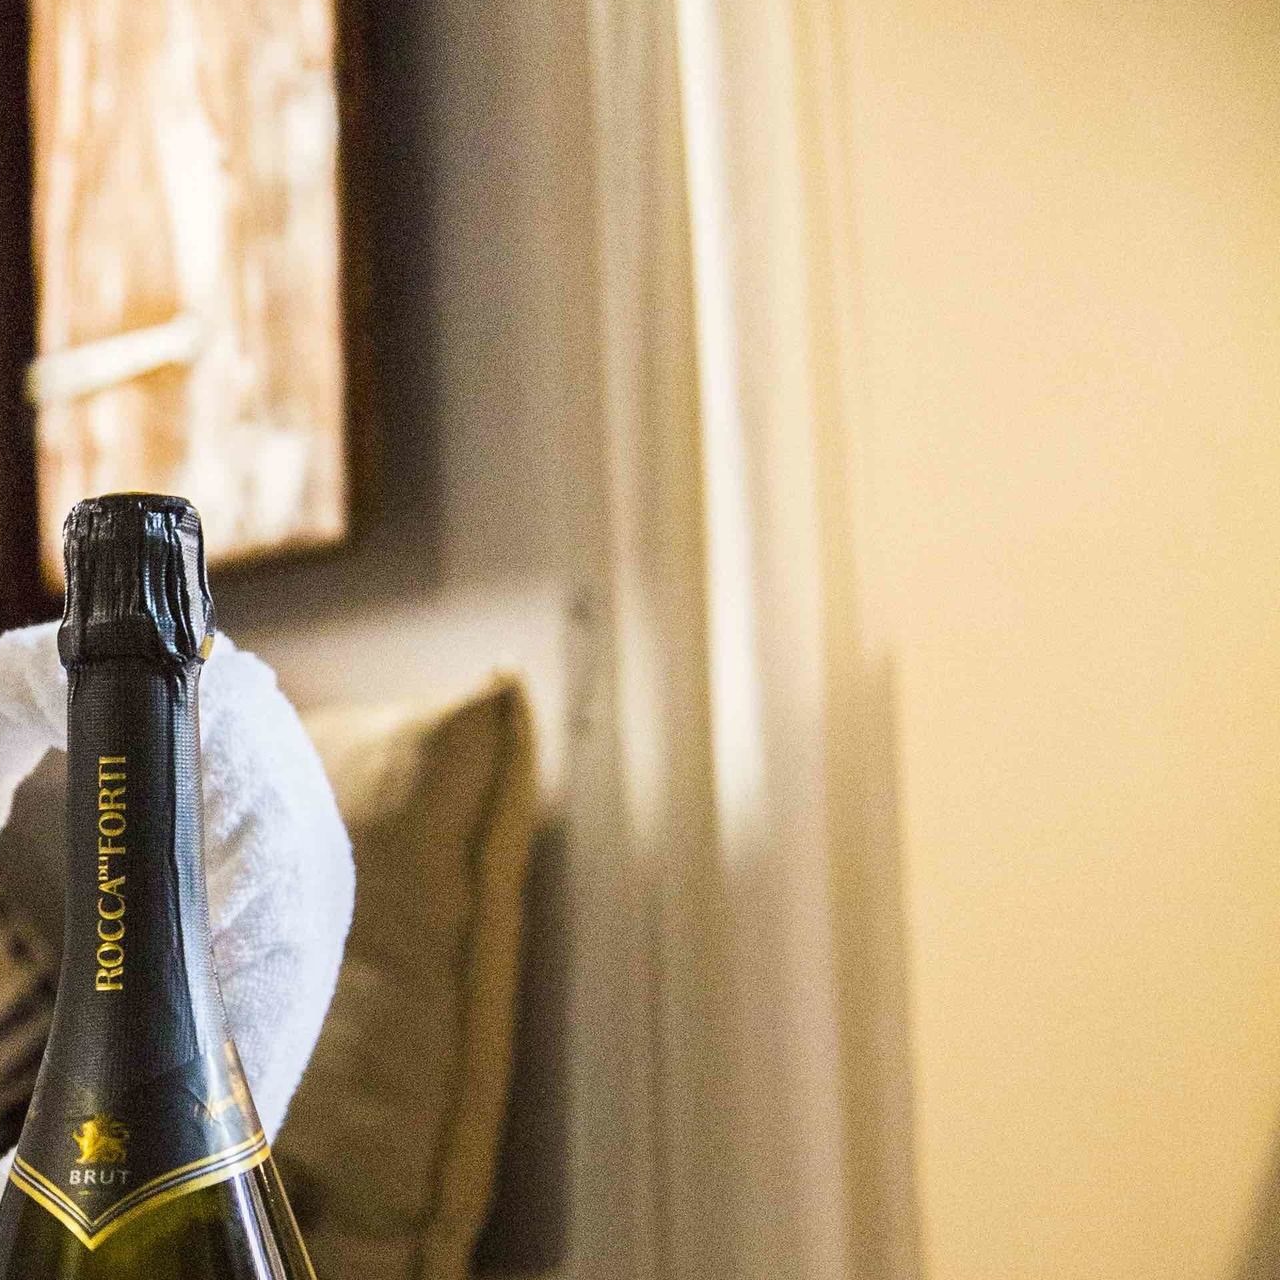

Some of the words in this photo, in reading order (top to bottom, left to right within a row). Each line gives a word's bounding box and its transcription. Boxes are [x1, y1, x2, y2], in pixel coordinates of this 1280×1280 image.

[99, 756, 127, 854] FORTI
[96, 875, 126, 991] ROCCA
[69, 1169, 131, 1185] BRUT
